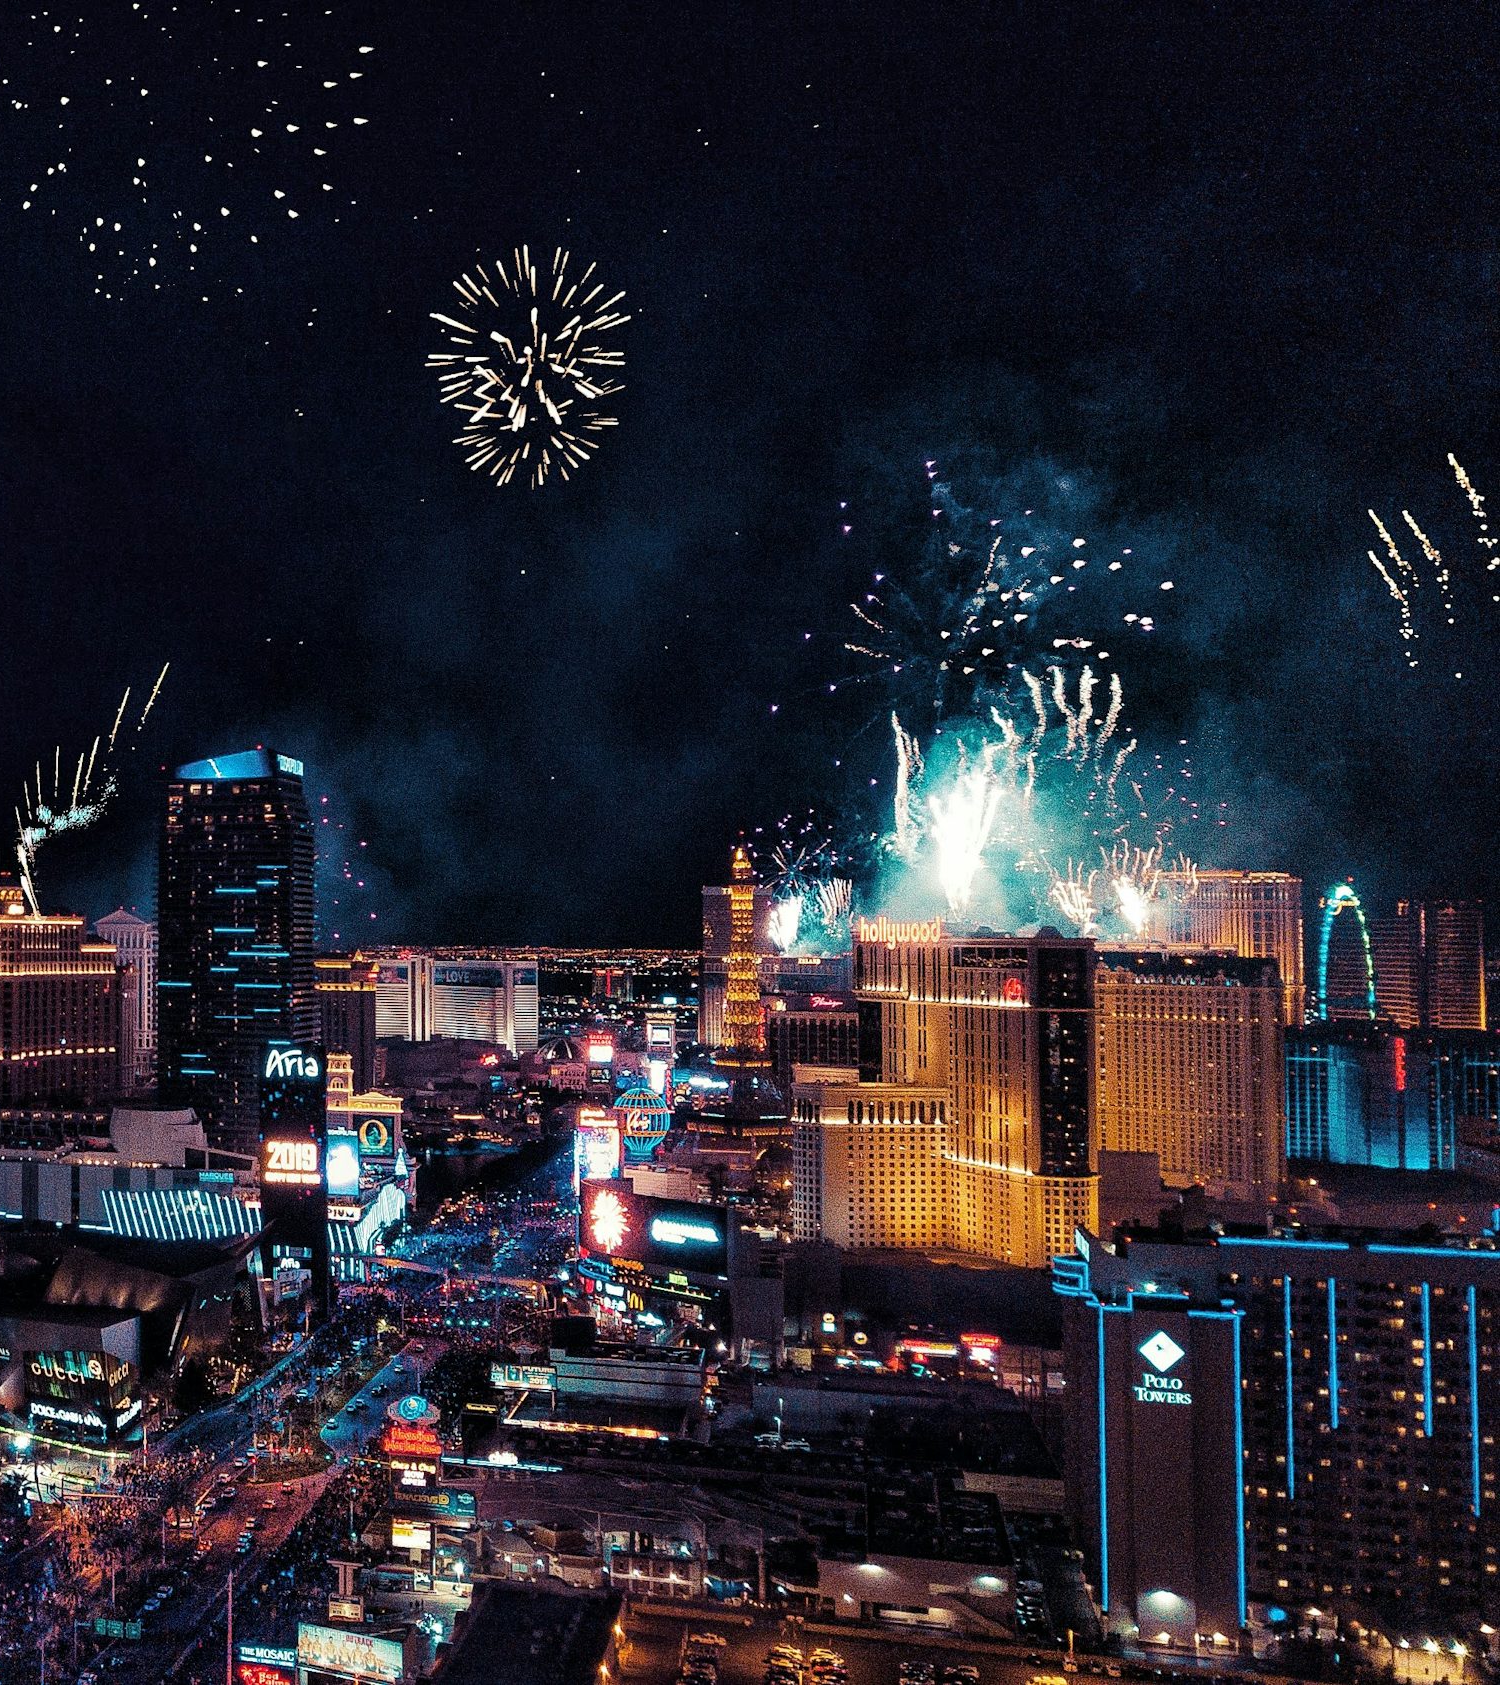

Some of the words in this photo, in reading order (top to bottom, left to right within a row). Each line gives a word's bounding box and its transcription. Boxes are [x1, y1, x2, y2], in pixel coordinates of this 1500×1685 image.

[860, 916, 940, 950] hollywood
[266, 1050, 318, 1078] Aria
[266, 1141, 317, 1171] 2019
[31, 1362, 86, 1385] GUCCI
[109, 1362, 129, 1387] GUCCI
[1143, 1373, 1183, 1390] POLO
[1133, 1386, 1193, 1405] TOWERS
[240, 1647, 255, 1655] THE
[255, 1648, 295, 1661] MOSAIC
